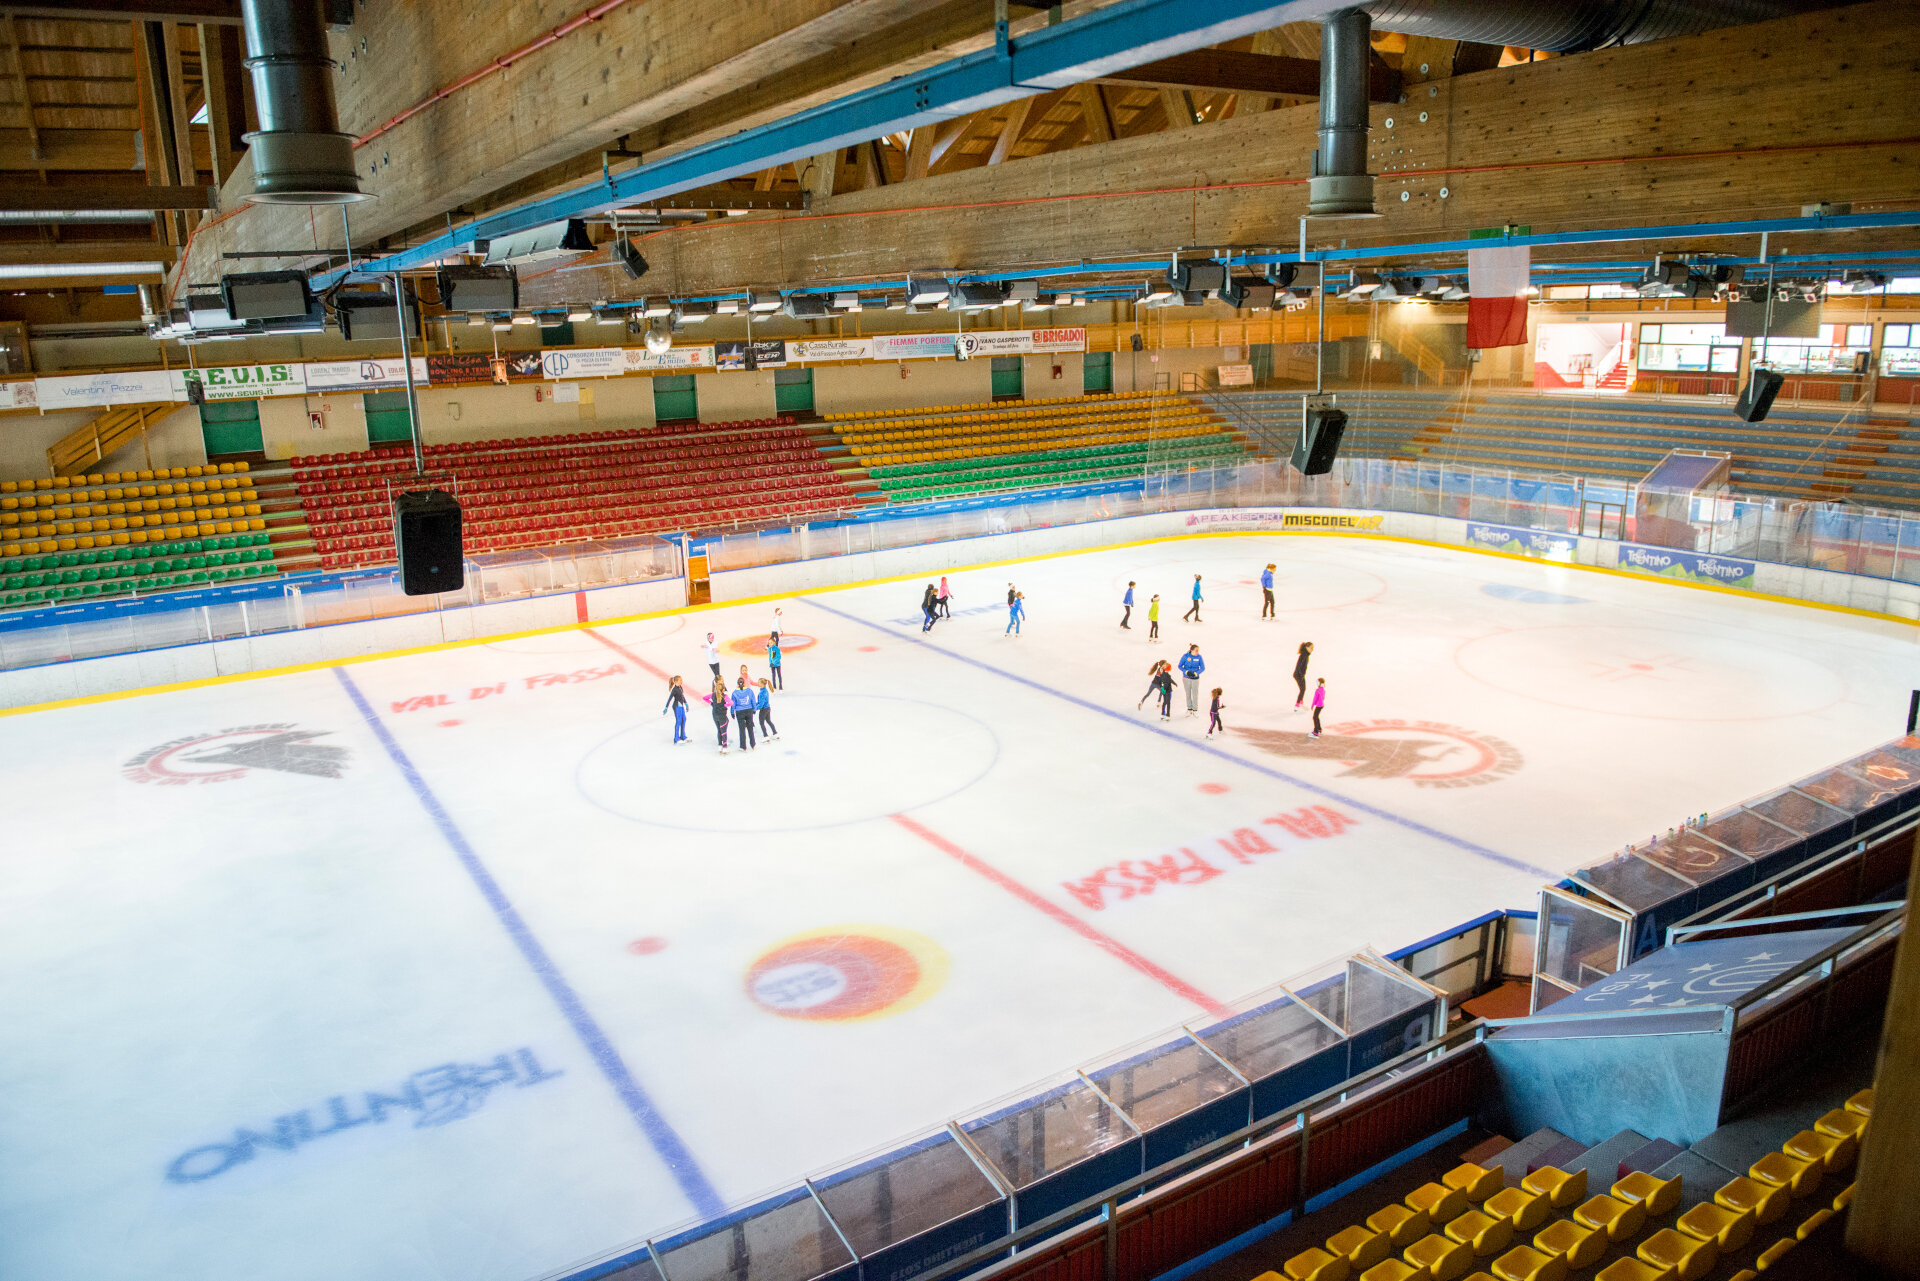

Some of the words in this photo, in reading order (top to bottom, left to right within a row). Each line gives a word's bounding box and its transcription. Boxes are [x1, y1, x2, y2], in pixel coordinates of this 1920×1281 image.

[890, 338, 917, 346] FIEMME
[920, 337, 950, 345] PORFIDI
[1043, 329, 1083, 342] BRIGADOI
[430, 367, 463, 375] BOWLING
[543, 352, 569, 376] CEP
[110, 384, 143, 393] Pezzei
[1285, 515, 1355, 527] MISCONEL
[1627, 548, 1671, 567] TRENTINO
[1697, 558, 1744, 577] TRENTINO
[390, 694, 455, 713] VAL
[523, 663, 628, 690] FASSA
[1261, 804, 1363, 839] VAL
[1060, 847, 1227, 912] FASSA
[165, 1046, 565, 1184] TRENTINO
